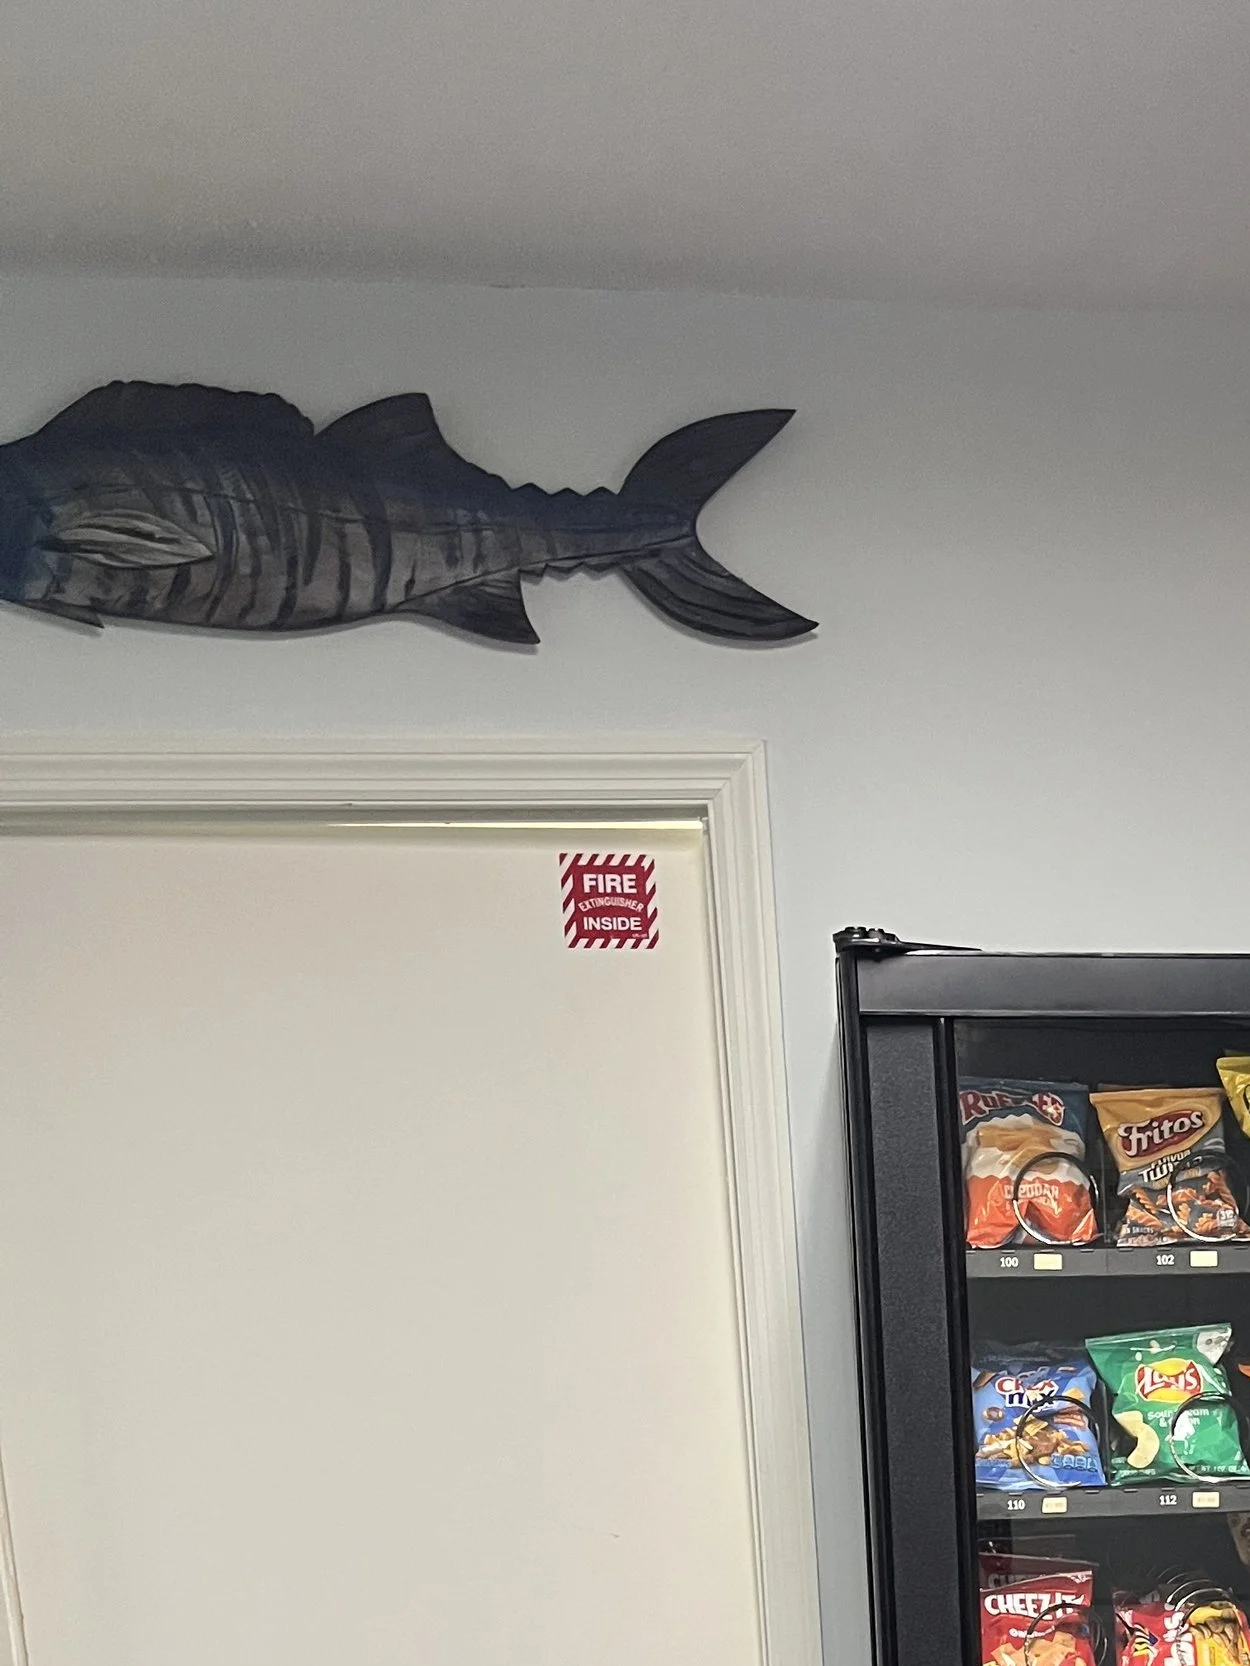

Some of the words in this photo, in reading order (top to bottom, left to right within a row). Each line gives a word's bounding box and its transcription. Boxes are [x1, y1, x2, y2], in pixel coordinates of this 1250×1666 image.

[583, 873, 637, 893] FIRE
[578, 897, 644, 912] EXTINGUISHER
[583, 917, 642, 930] INSIDE
[1118, 1110, 1205, 1156] Fritos
[1000, 1256, 1019, 1268] 100
[1156, 1254, 1175, 1266] 102
[998, 1378, 1055, 1392] Chx
[1147, 1410, 1173, 1420] Sour
[1007, 1499, 1025, 1510] 110
[1159, 1494, 1177, 1505] 112
